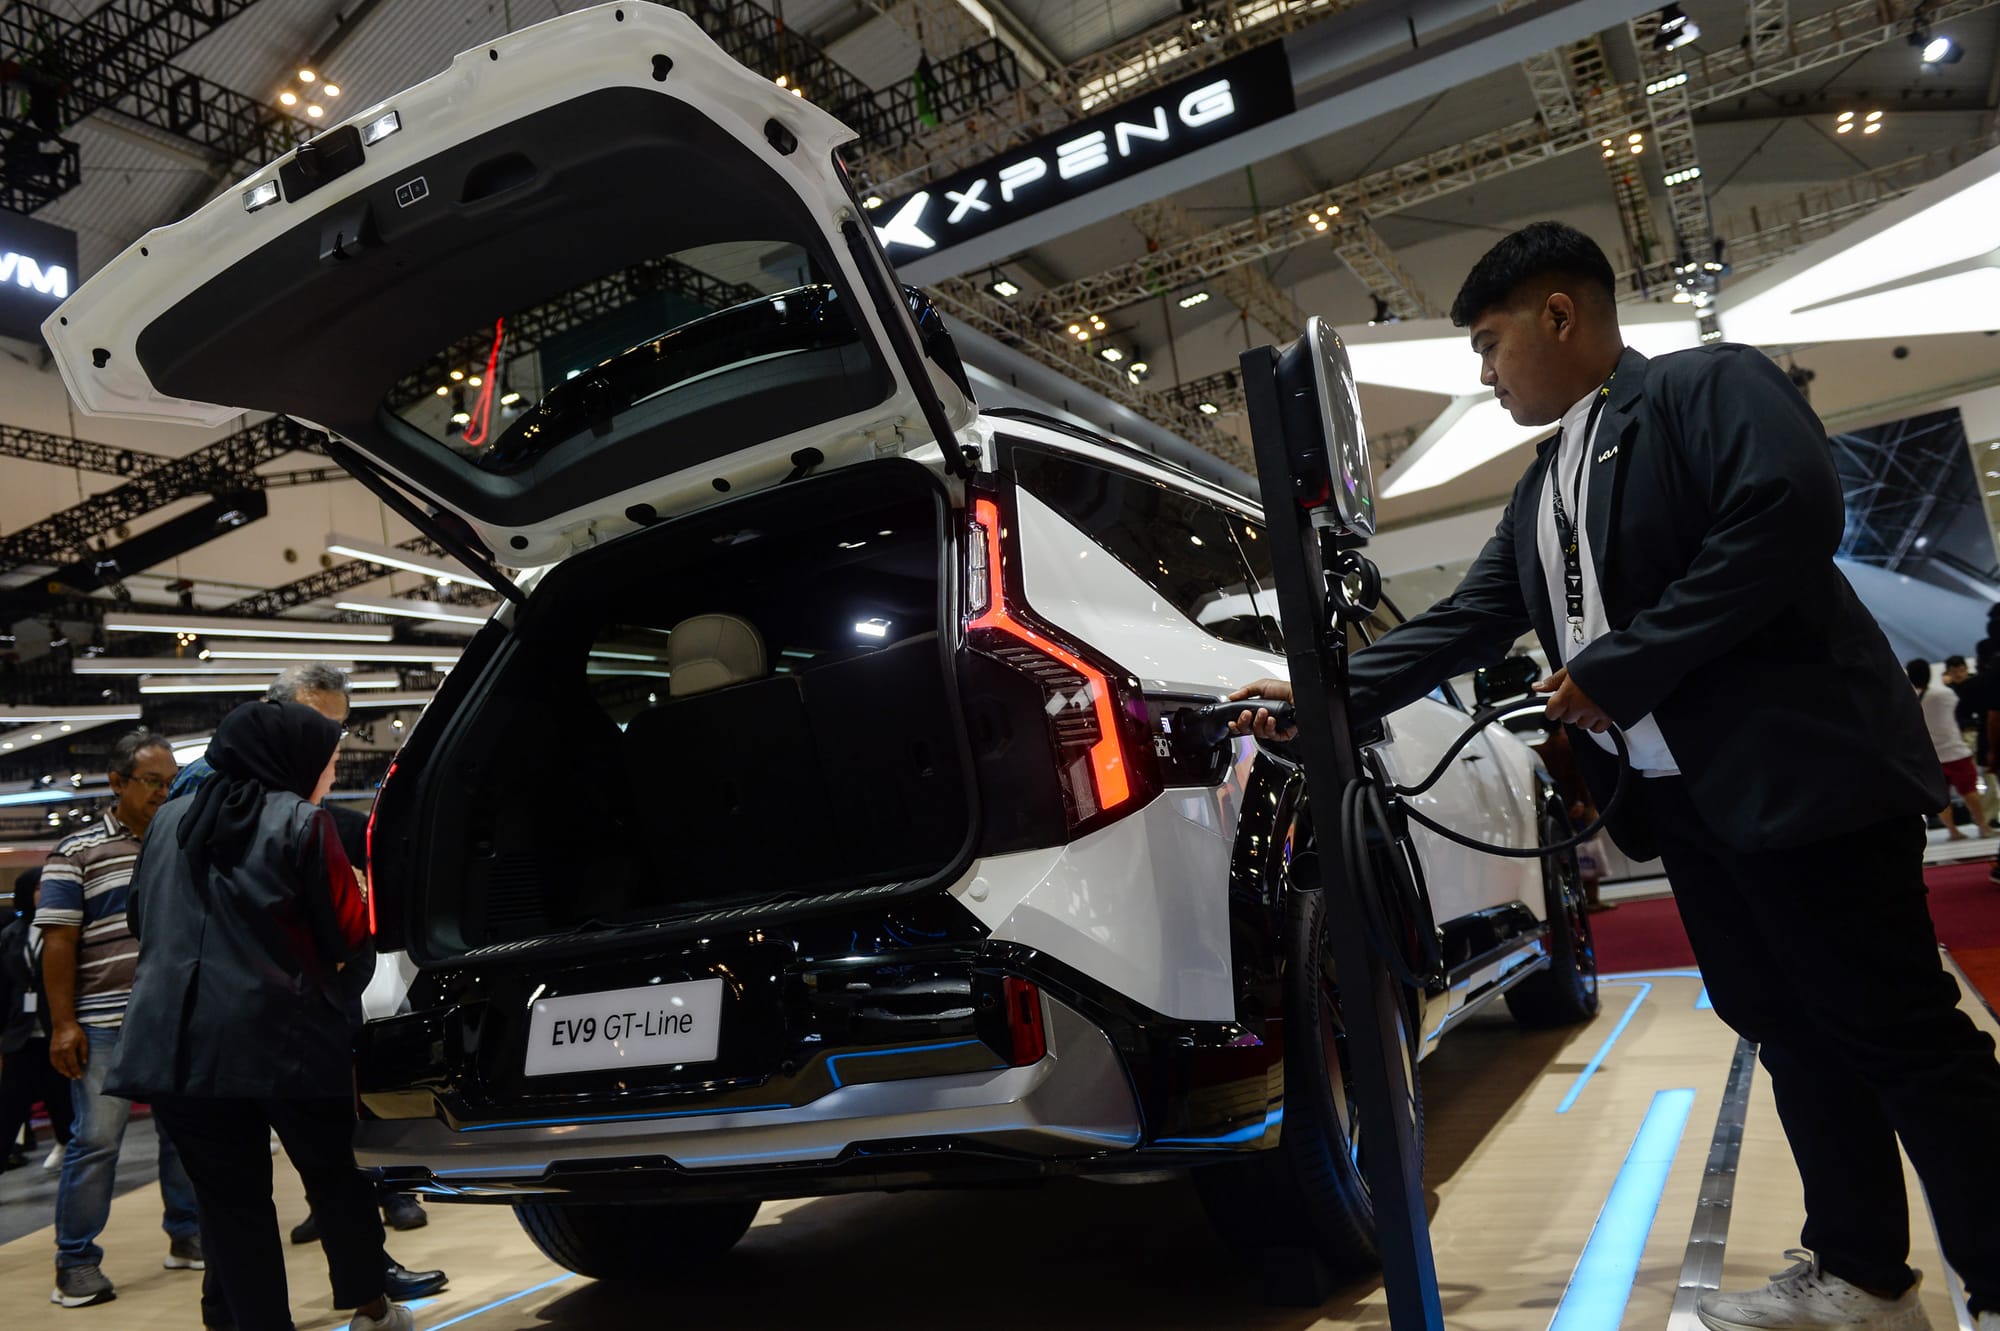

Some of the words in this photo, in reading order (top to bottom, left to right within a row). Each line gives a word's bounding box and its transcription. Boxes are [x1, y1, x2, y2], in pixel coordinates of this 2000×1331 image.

[944, 78, 1235, 224] XPENG
[551, 1017, 597, 1046] EV9
[603, 1010, 693, 1041] GT-Line
